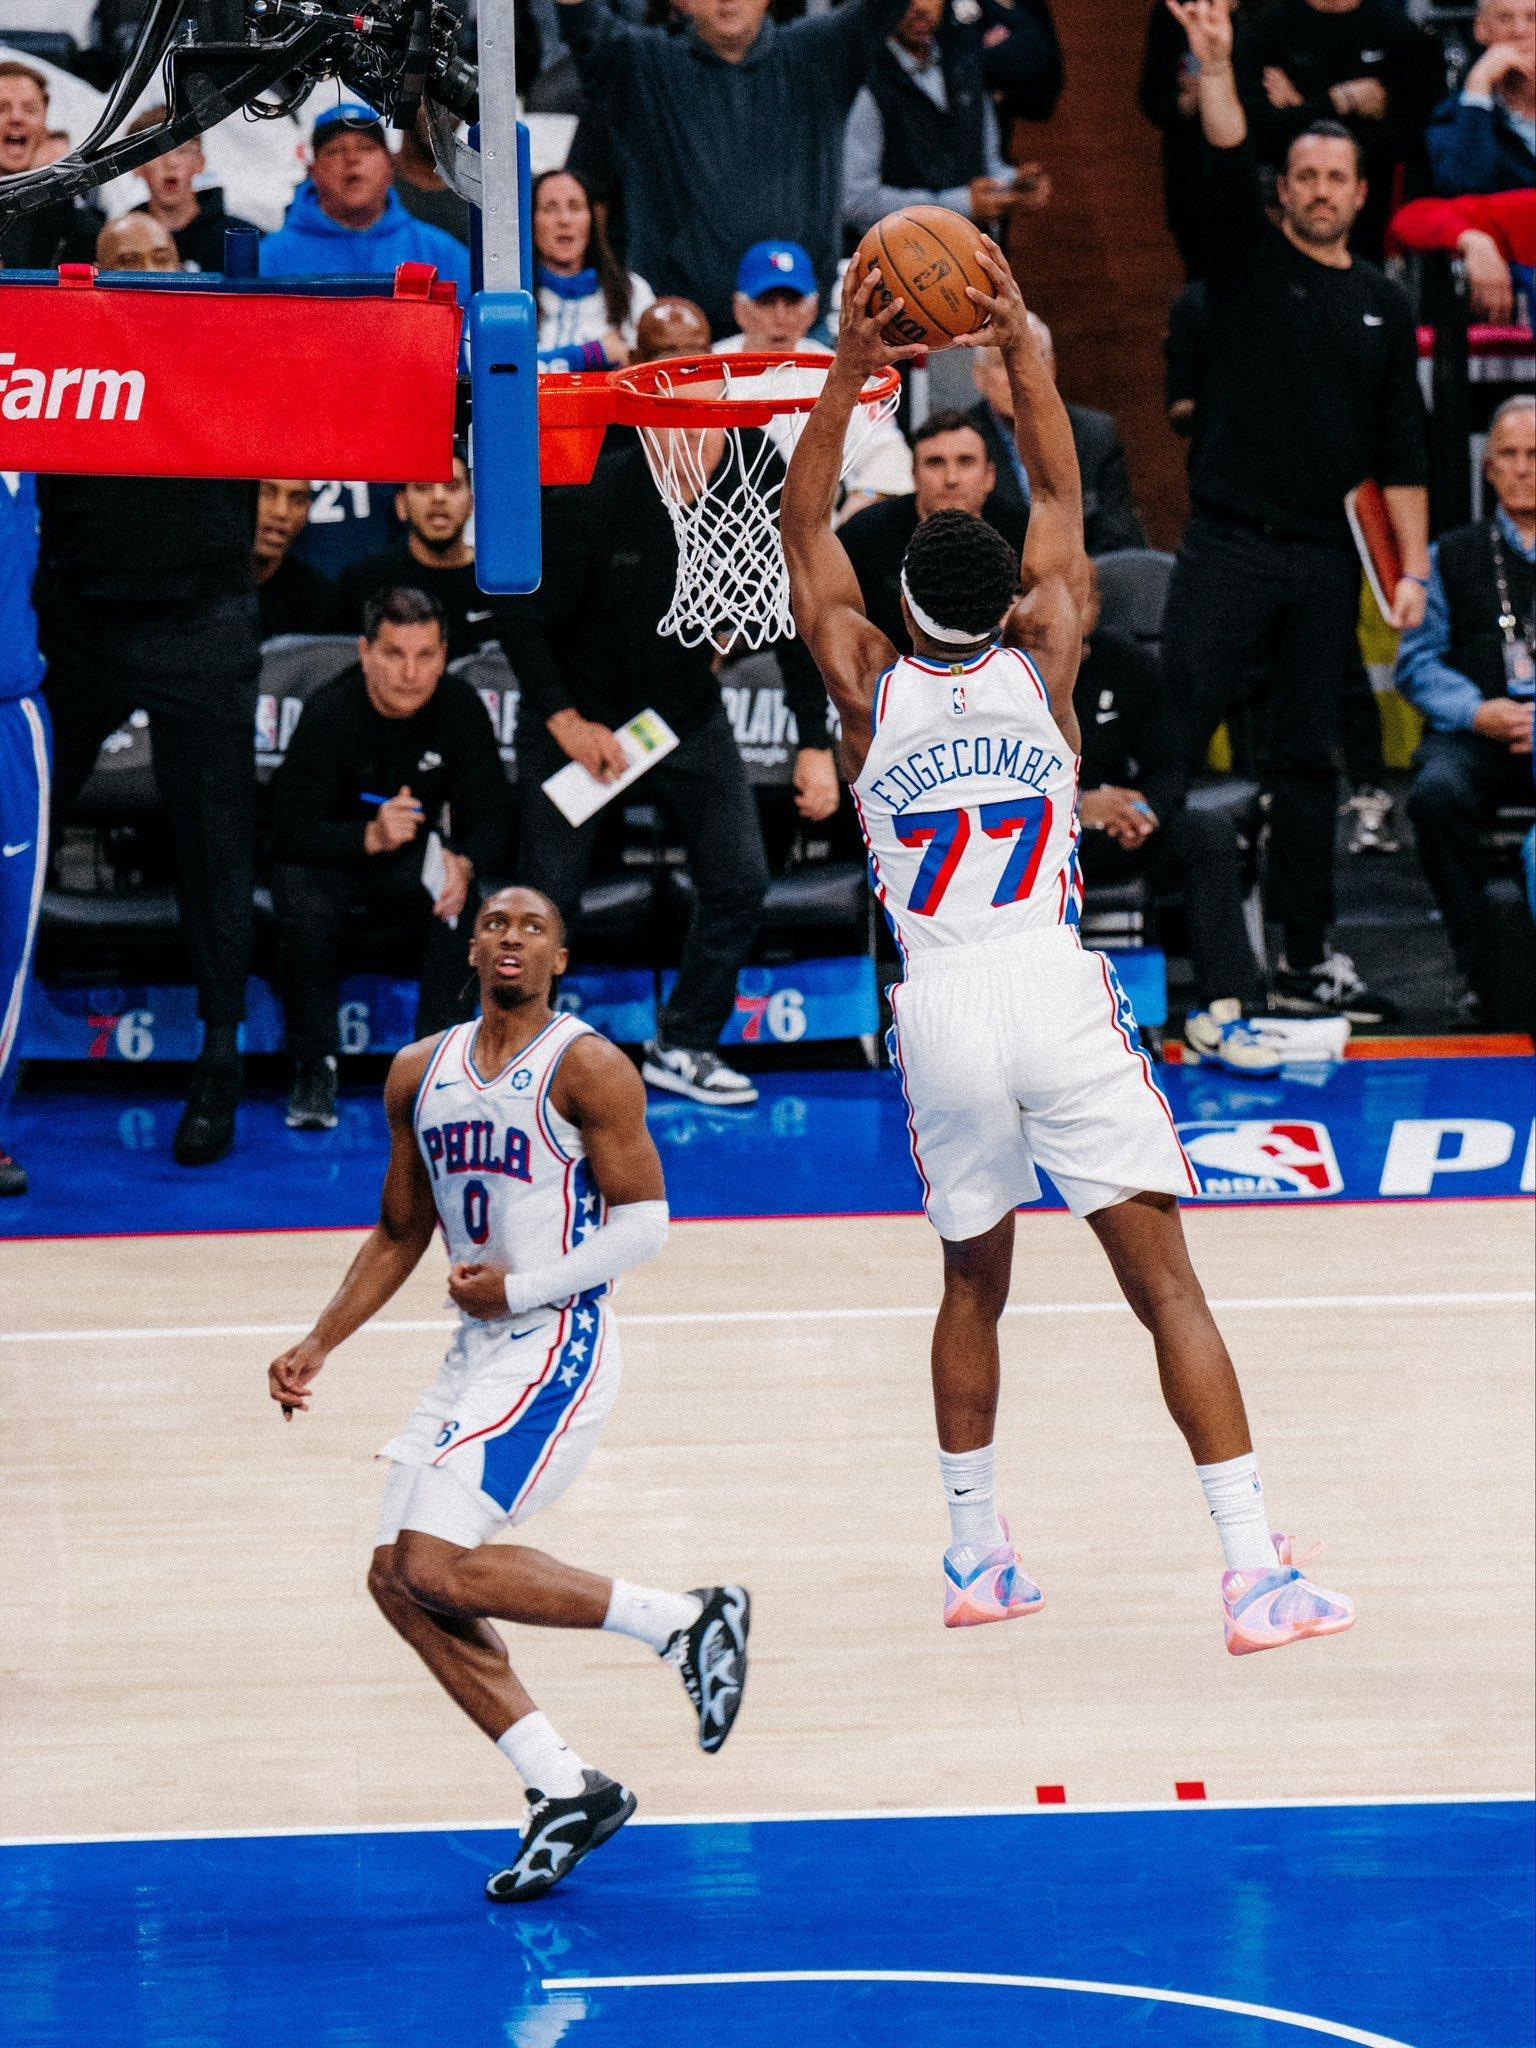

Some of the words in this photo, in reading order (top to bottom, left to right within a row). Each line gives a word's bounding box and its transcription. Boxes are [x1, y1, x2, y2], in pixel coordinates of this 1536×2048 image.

[308, 480, 371, 524] 21
[870, 736, 1063, 815] EDGECOMBE
[891, 795, 1054, 918] 77
[88, 1010, 154, 1062] 76
[338, 1001, 370, 1054] 6
[735, 989, 807, 1043] 76
[422, 1119, 534, 1184] PHILA
[1378, 1117, 1536, 1196] P
[463, 1179, 491, 1246] 0
[1204, 1176, 1281, 1194] NBA
